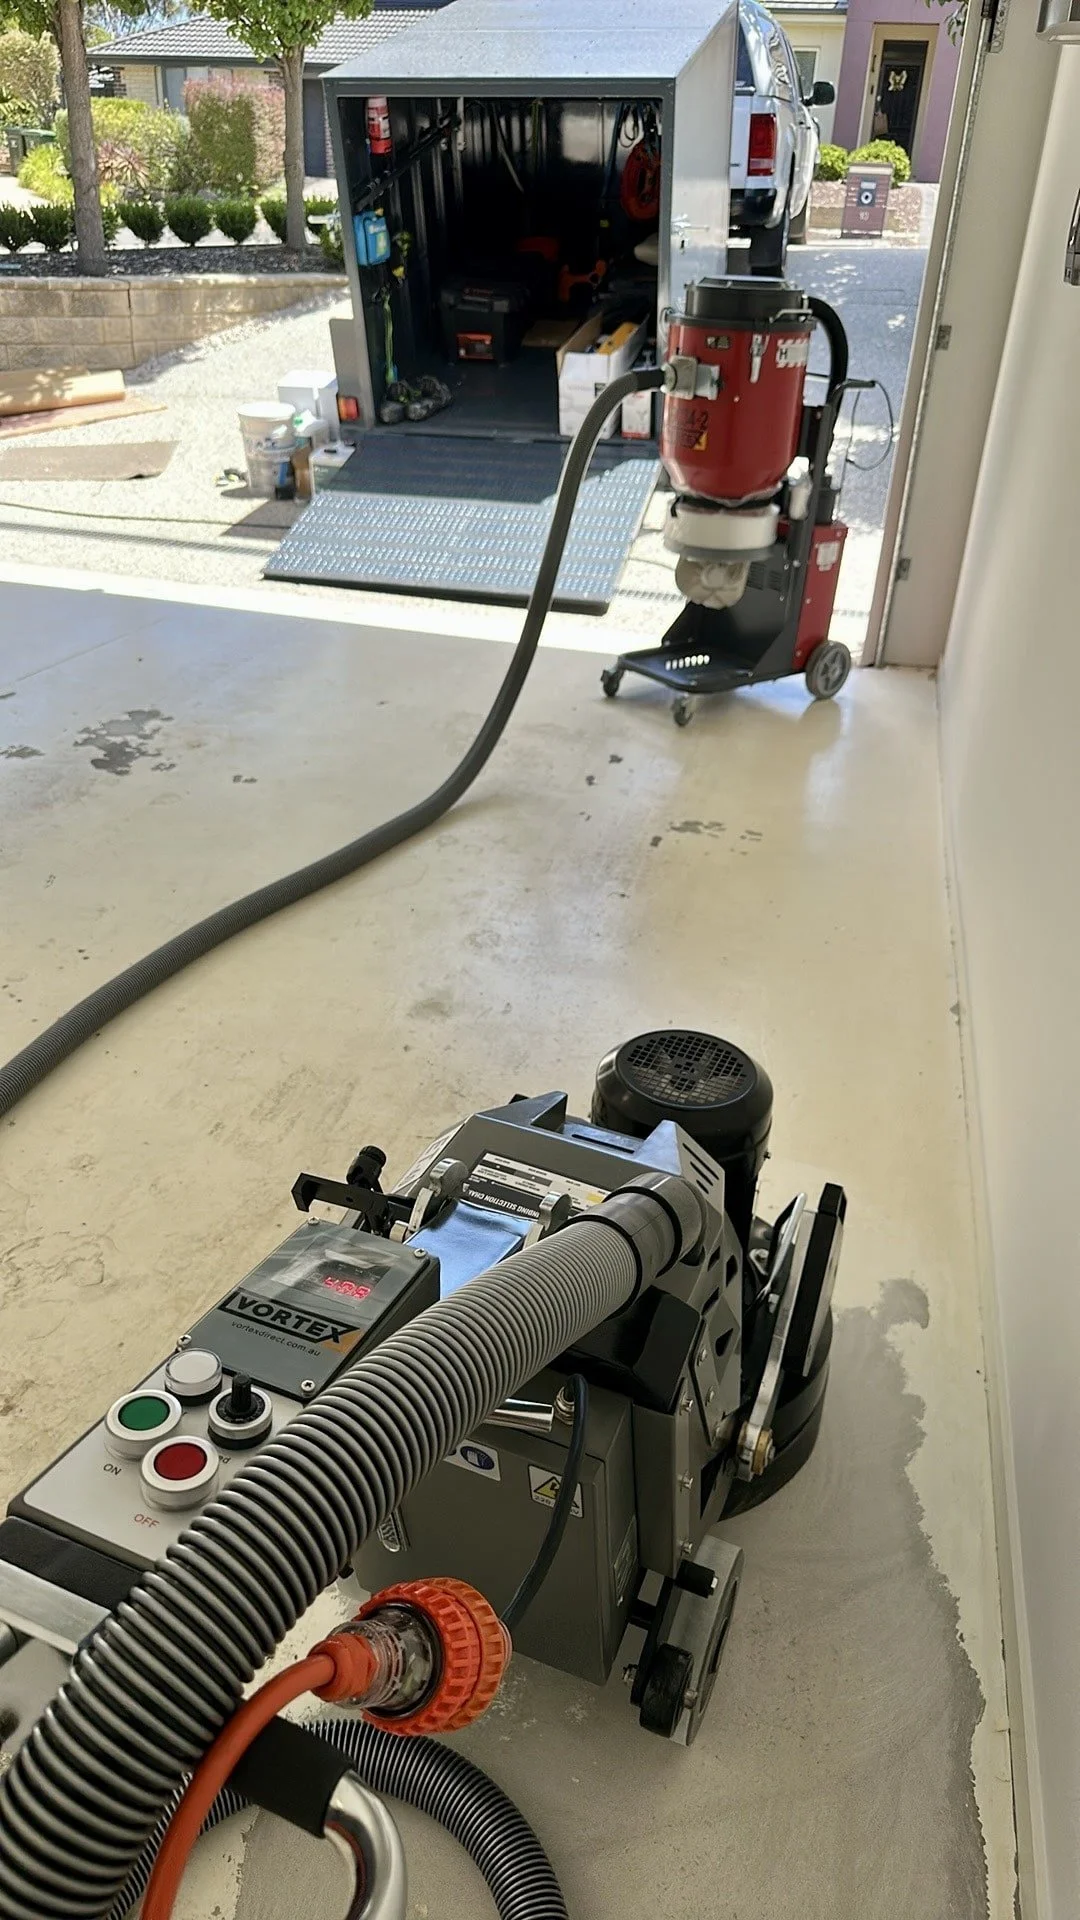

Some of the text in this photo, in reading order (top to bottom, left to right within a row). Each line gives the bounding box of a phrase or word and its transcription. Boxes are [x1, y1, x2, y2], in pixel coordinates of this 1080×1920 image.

[484, 1194, 518, 1211] SELECTION
[237, 1295, 340, 1344] VORTEX
[231, 1320, 322, 1357] vortexdirect.com.au
[102, 1463, 122, 1476] ON
[133, 1513, 160, 1528] OFF
